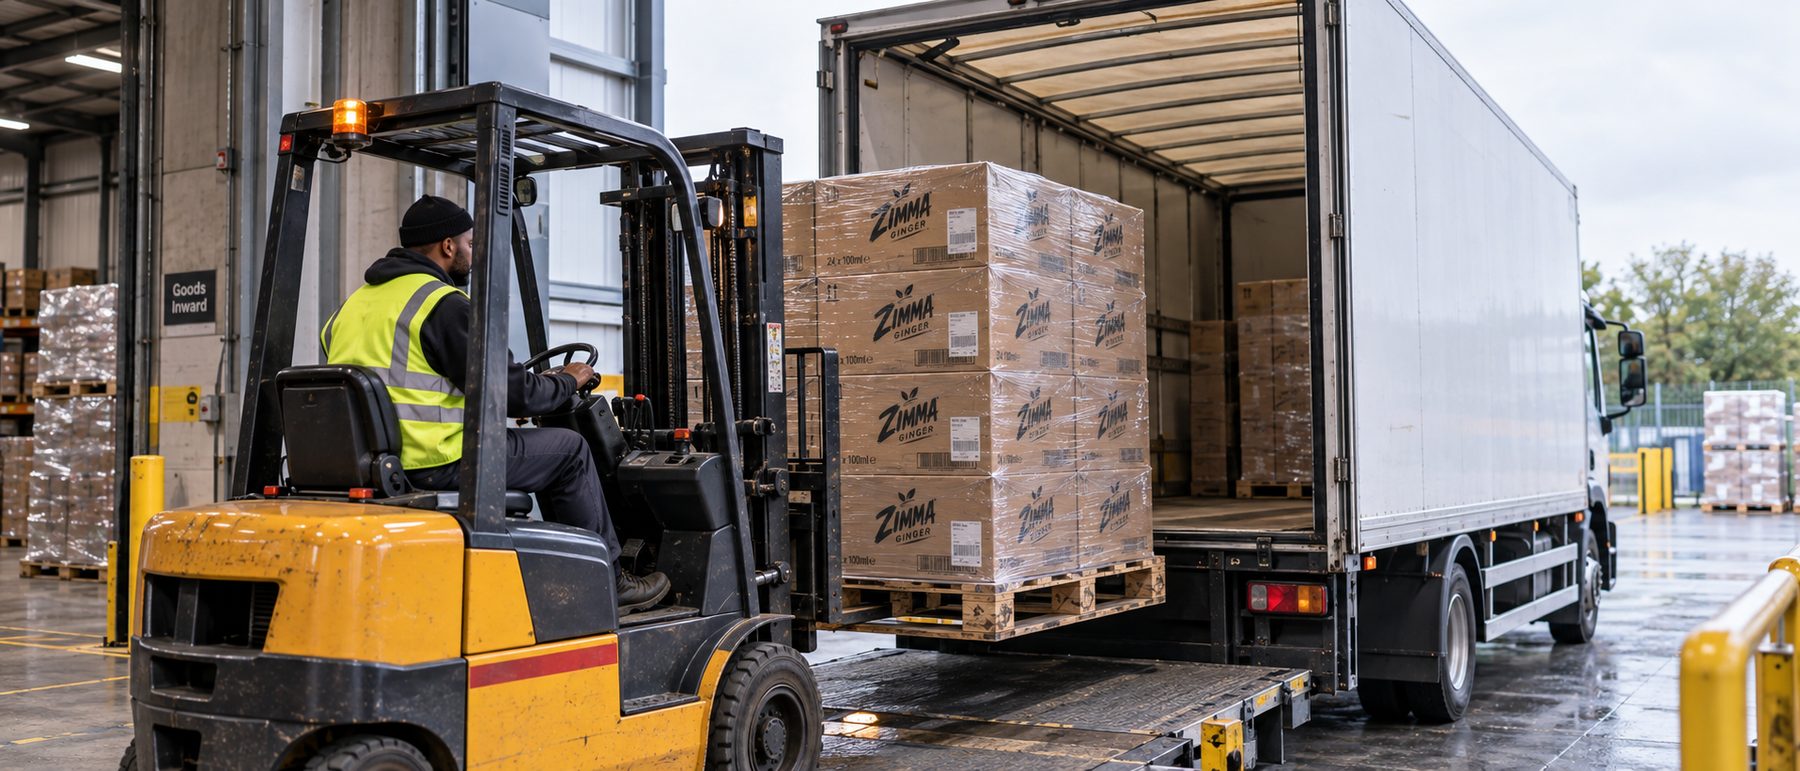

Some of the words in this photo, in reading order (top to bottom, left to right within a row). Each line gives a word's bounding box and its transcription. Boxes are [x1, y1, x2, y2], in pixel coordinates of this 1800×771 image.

[869, 191, 932, 243] ZIMMA
[890, 219, 926, 239] GINGER
[1093, 222, 1124, 256] ZIMMA
[826, 256, 837, 267] 24
[172, 281, 206, 296] Goods
[172, 298, 207, 314] Inward
[873, 293, 935, 342] ZIMMA
[893, 322, 929, 339] GINGER
[1015, 300, 1051, 340] ZIMMA
[1095, 311, 1125, 347] ZIMMA
[877, 396, 939, 443] ZIMMA
[899, 425, 934, 442] GINGER
[1017, 396, 1052, 441] ZIMMA
[1097, 401, 1128, 440] ZIMMA
[874, 499, 936, 544] ZIMMA
[1017, 496, 1054, 544] ZIMMA
[1100, 490, 1130, 534] ZIMMA
[895, 527, 931, 543] GINGER
